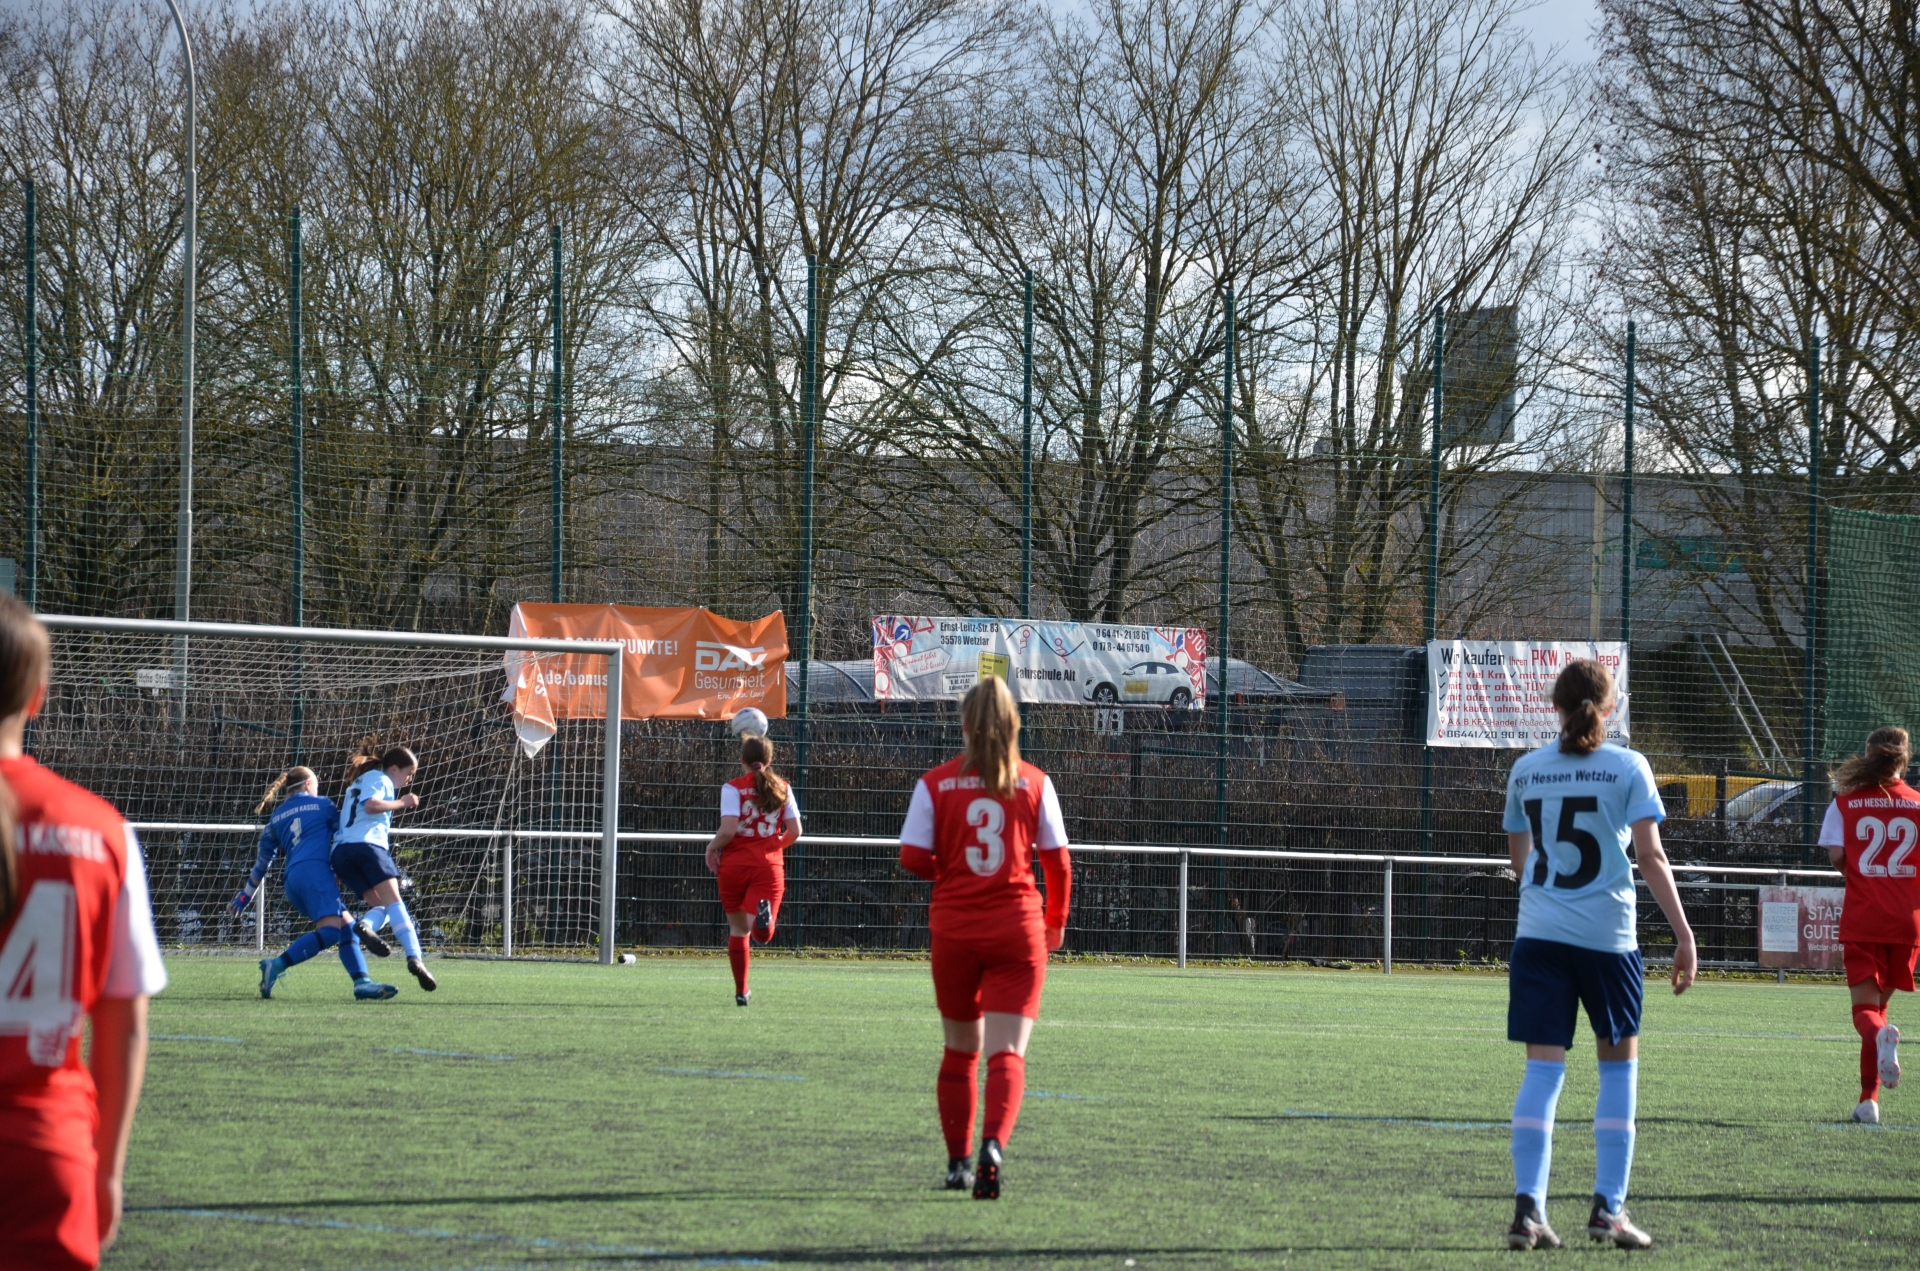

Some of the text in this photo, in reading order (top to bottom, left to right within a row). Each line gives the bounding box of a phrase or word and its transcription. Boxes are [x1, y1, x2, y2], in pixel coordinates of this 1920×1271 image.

[940, 622, 999, 633] Ernst-Leitz-Str. 83
[940, 635, 989, 646] 35578 Wetzlar
[1441, 647, 1460, 665] Wir
[1463, 647, 1505, 666] kaufen
[1509, 656, 1527, 666] Ihren
[1531, 649, 1561, 667] PKW,
[1016, 667, 1076, 681] Fahrschule Alt
[1448, 670, 1462, 679] mit
[1466, 670, 1484, 679] viel
[1488, 670, 1506, 679] Km
[1519, 671, 1536, 679] mit
[1448, 681, 1546, 691] mit oder ohne TÜV
[1447, 693, 1462, 702] mit
[1466, 693, 1490, 702] oder
[1494, 693, 1521, 702] ohne
[1446, 704, 1460, 712] wir
[1463, 704, 1493, 713] kaufen
[1497, 704, 1520, 713] ohne
[1471, 718, 1517, 726] KFZ-Handel
[1447, 731, 1497, 739] 06441/20
[1501, 731, 1514, 739] 90
[1518, 731, 1528, 739] 81
[1531, 771, 1571, 785] Hessen
[1575, 769, 1618, 784] Wetzlar
[299, 803, 320, 812] KASSEL
[1848, 799, 1863, 809] KSV
[1864, 797, 1894, 808] HESSEN
[290, 817, 302, 846] 1
[965, 797, 1005, 876] 3
[29, 821, 108, 864] KASSEL
[1523, 796, 1601, 890] 15
[1856, 816, 1918, 877] 22
